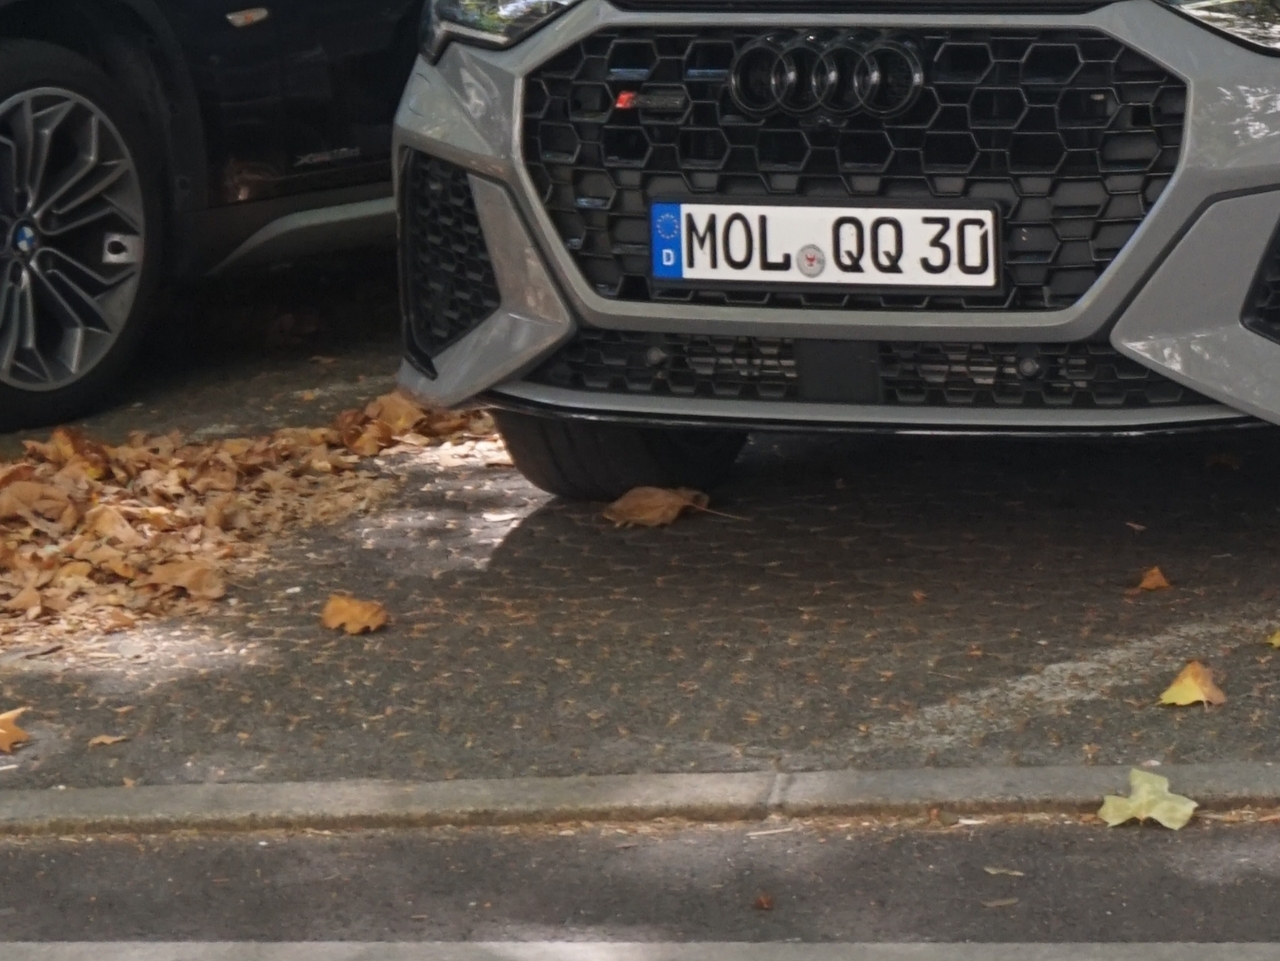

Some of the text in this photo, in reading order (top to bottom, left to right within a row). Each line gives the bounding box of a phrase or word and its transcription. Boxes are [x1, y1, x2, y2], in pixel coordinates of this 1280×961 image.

[662, 248, 675, 267] D
[685, 212, 991, 276] MOL QQ 30
